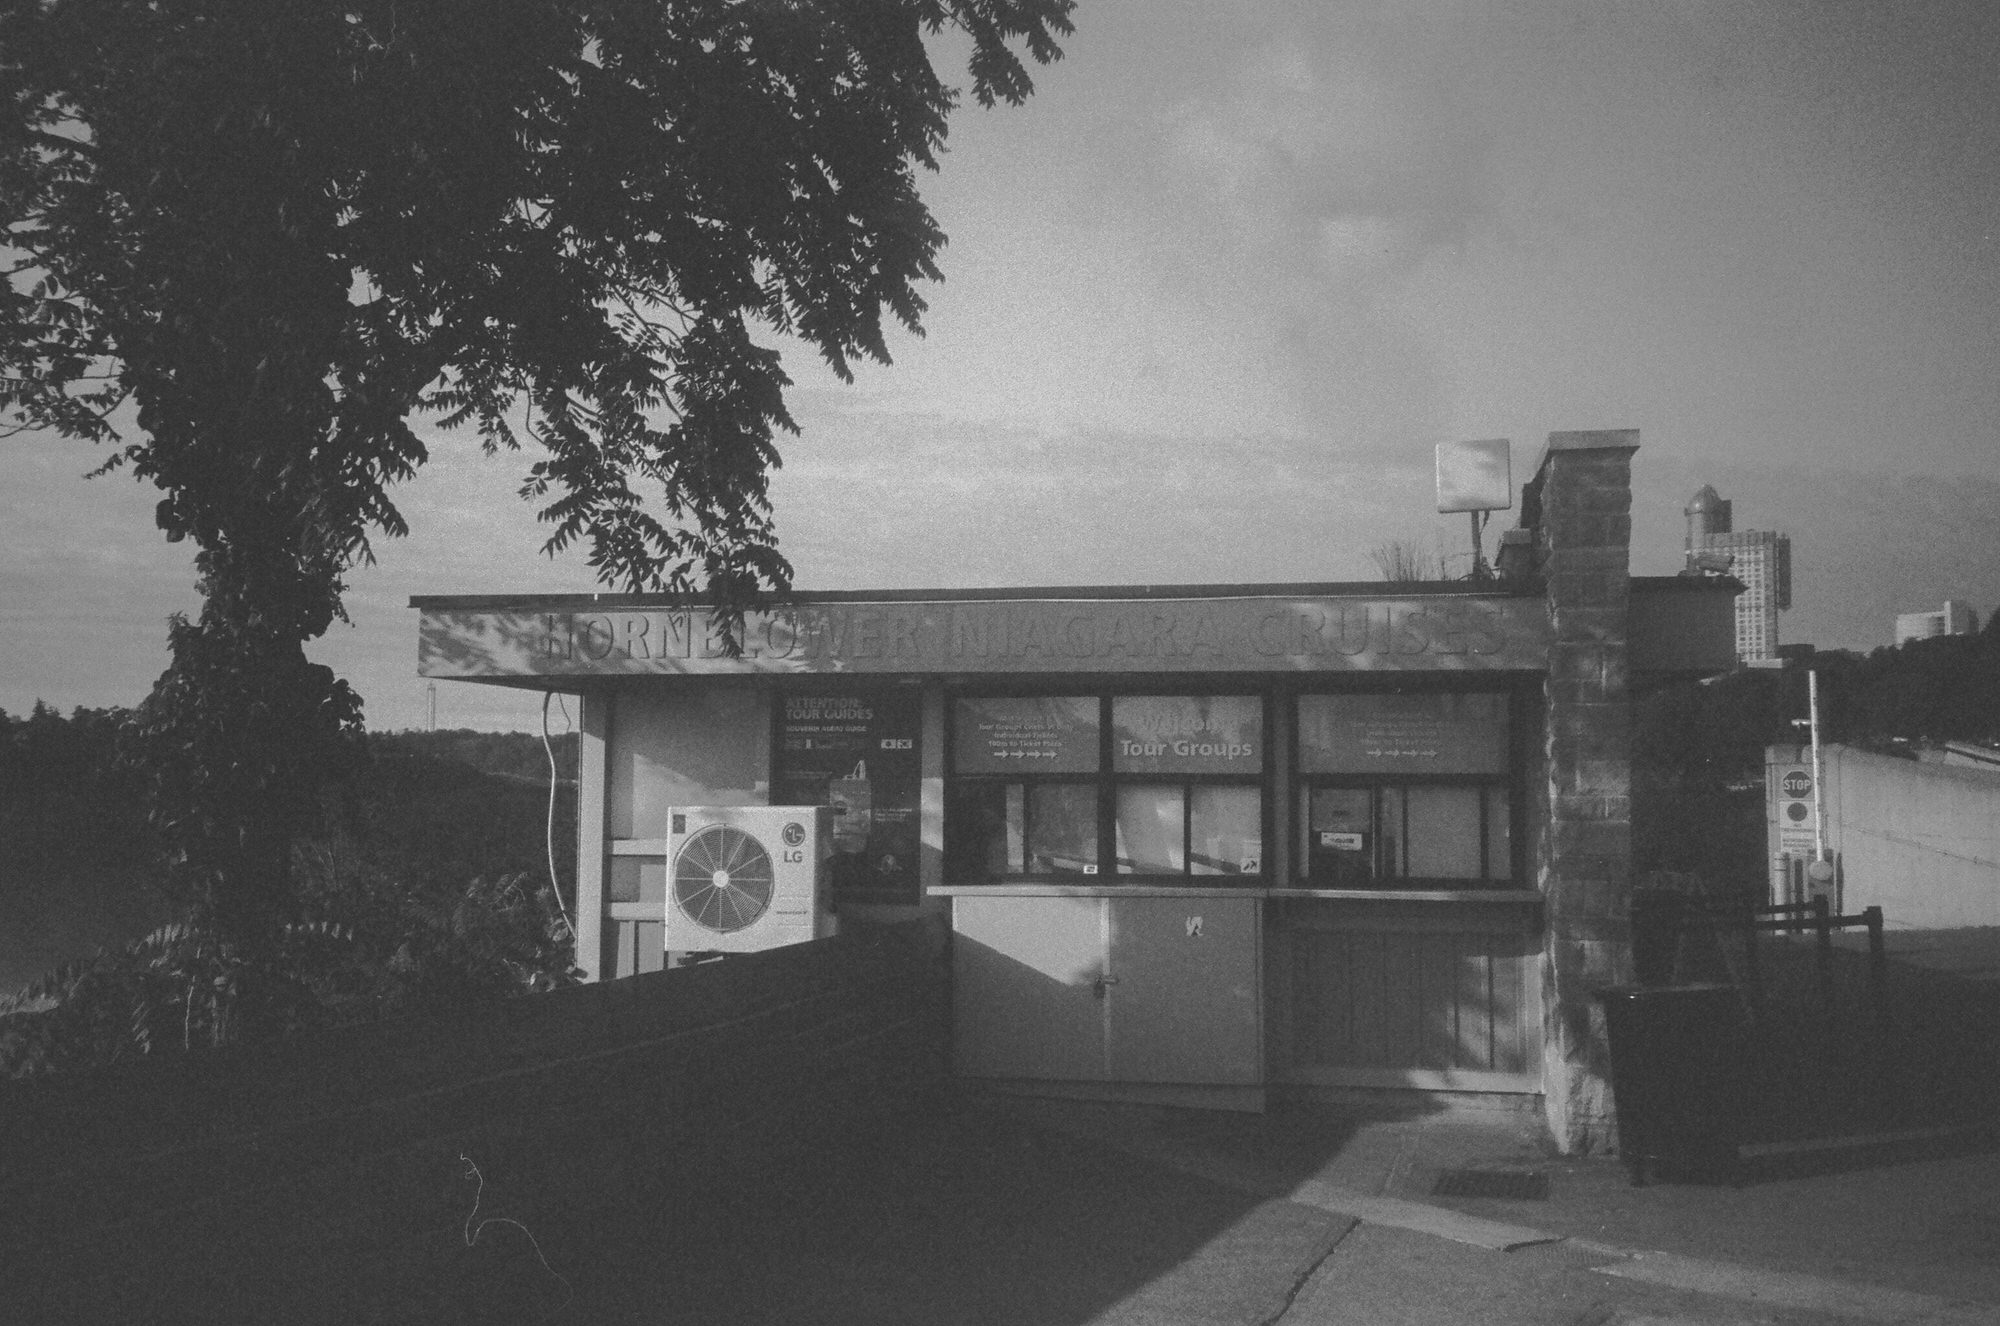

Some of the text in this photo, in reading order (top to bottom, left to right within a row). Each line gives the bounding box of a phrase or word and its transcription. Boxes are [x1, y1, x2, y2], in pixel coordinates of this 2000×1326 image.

[541, 604, 1506, 660] HORNBLOWER NIAGARA CRUISES
[824, 708, 874, 720] GUIDES
[1120, 739, 1252, 760] Tour Groups
[1783, 779, 1811, 791] STOP
[783, 851, 803, 863] LG
